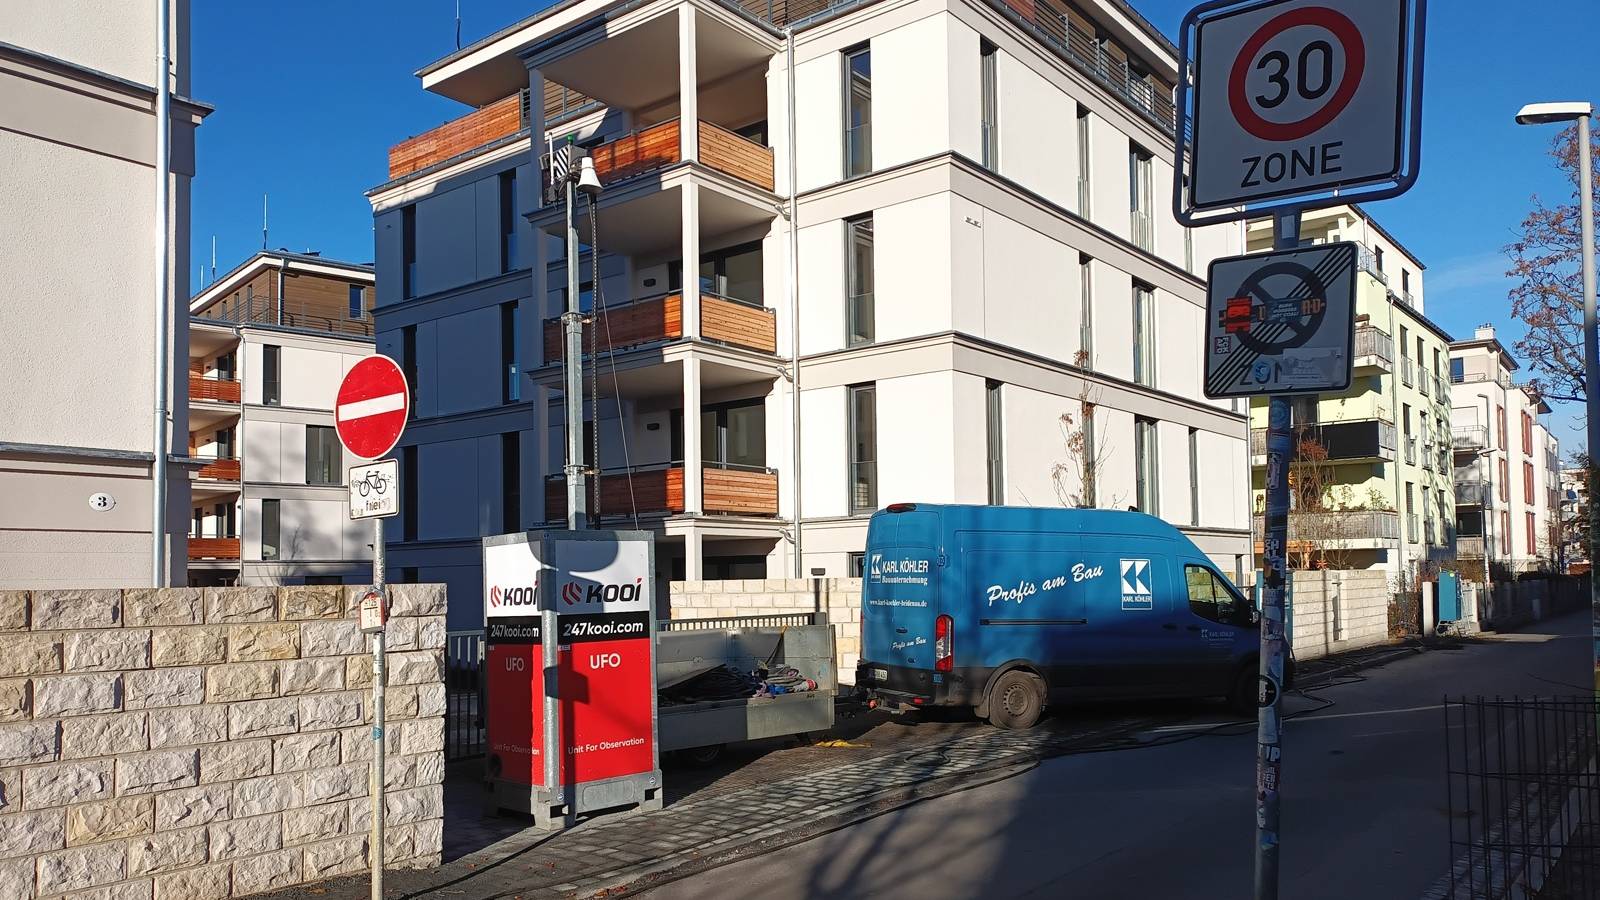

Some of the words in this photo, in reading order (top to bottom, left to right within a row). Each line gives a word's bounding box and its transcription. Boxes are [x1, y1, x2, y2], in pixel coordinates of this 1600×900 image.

[1255, 40, 1333, 109] 30
[1240, 140, 1343, 188] ZONE
[98, 496, 107, 507] 3
[882, 560, 898, 573] KARL
[900, 557, 929, 573] KÖHLER
[986, 580, 1037, 607] Profis
[1042, 575, 1067, 591] am
[1071, 562, 1104, 582] Bau
[491, 624, 539, 638] 247kooi.com
[563, 620, 644, 637] 247kooi.com
[505, 657, 525, 672] UFO
[589, 653, 621, 669] UFO
[567, 745, 584, 755] Unit
[585, 743, 598, 752] For
[599, 737, 645, 750] Observation
